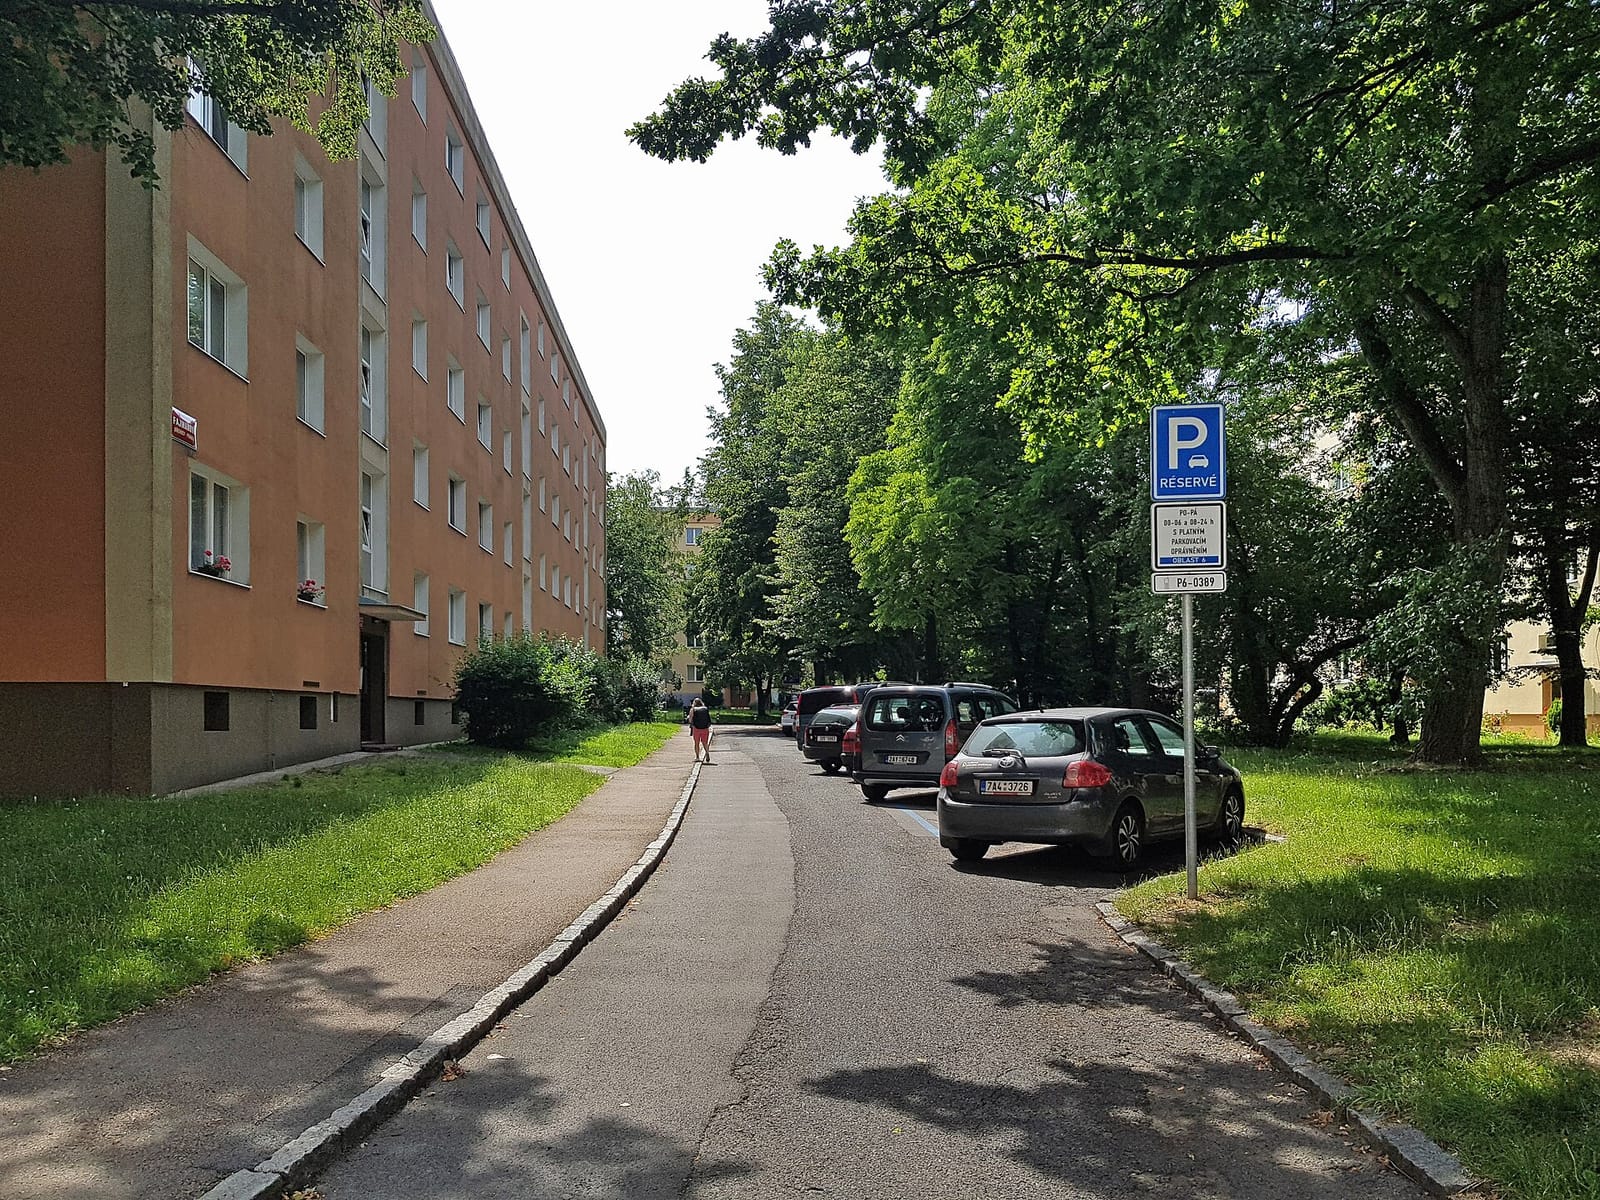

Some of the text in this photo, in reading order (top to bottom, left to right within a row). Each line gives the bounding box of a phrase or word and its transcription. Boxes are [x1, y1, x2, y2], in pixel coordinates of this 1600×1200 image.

[1168, 416, 1208, 470] P
[1160, 473, 1217, 489] RÉSERVÉ
[1172, 527, 1205, 536] S PLATNÝM
[1171, 537, 1207, 545] PARKOVACÍM
[1176, 577, 1215, 588] P6-0389
[987, 782, 1029, 792] 7A4 3726
